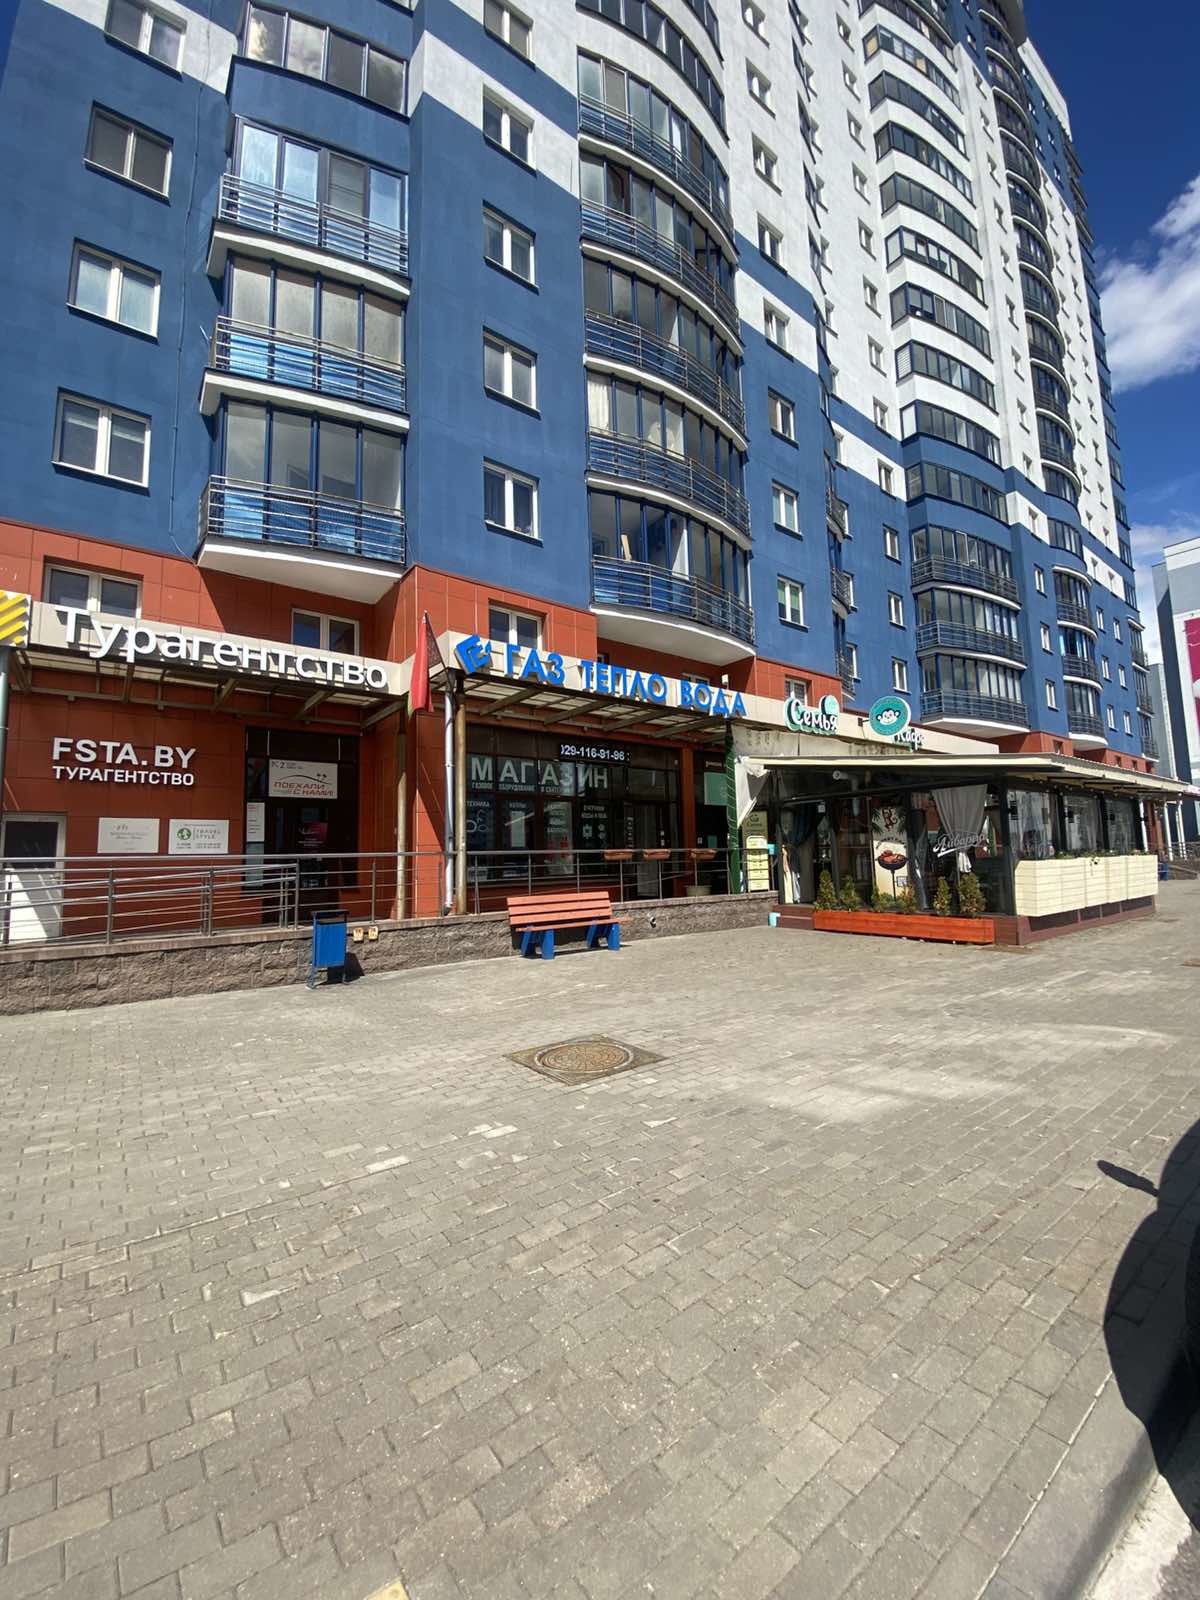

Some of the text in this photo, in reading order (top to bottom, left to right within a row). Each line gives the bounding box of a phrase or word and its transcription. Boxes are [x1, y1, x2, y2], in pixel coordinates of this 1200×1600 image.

[54, 605, 388, 689] Турагентство
[505, 643, 566, 686] ГАЗ
[580, 660, 668, 703] ТЕПЛО
[680, 679, 748, 717] ВОДА
[791, 698, 838, 731] Семья
[52, 766, 195, 786] ТУРАГЕНТСТВО
[471, 756, 608, 789] МАГАЗИН
